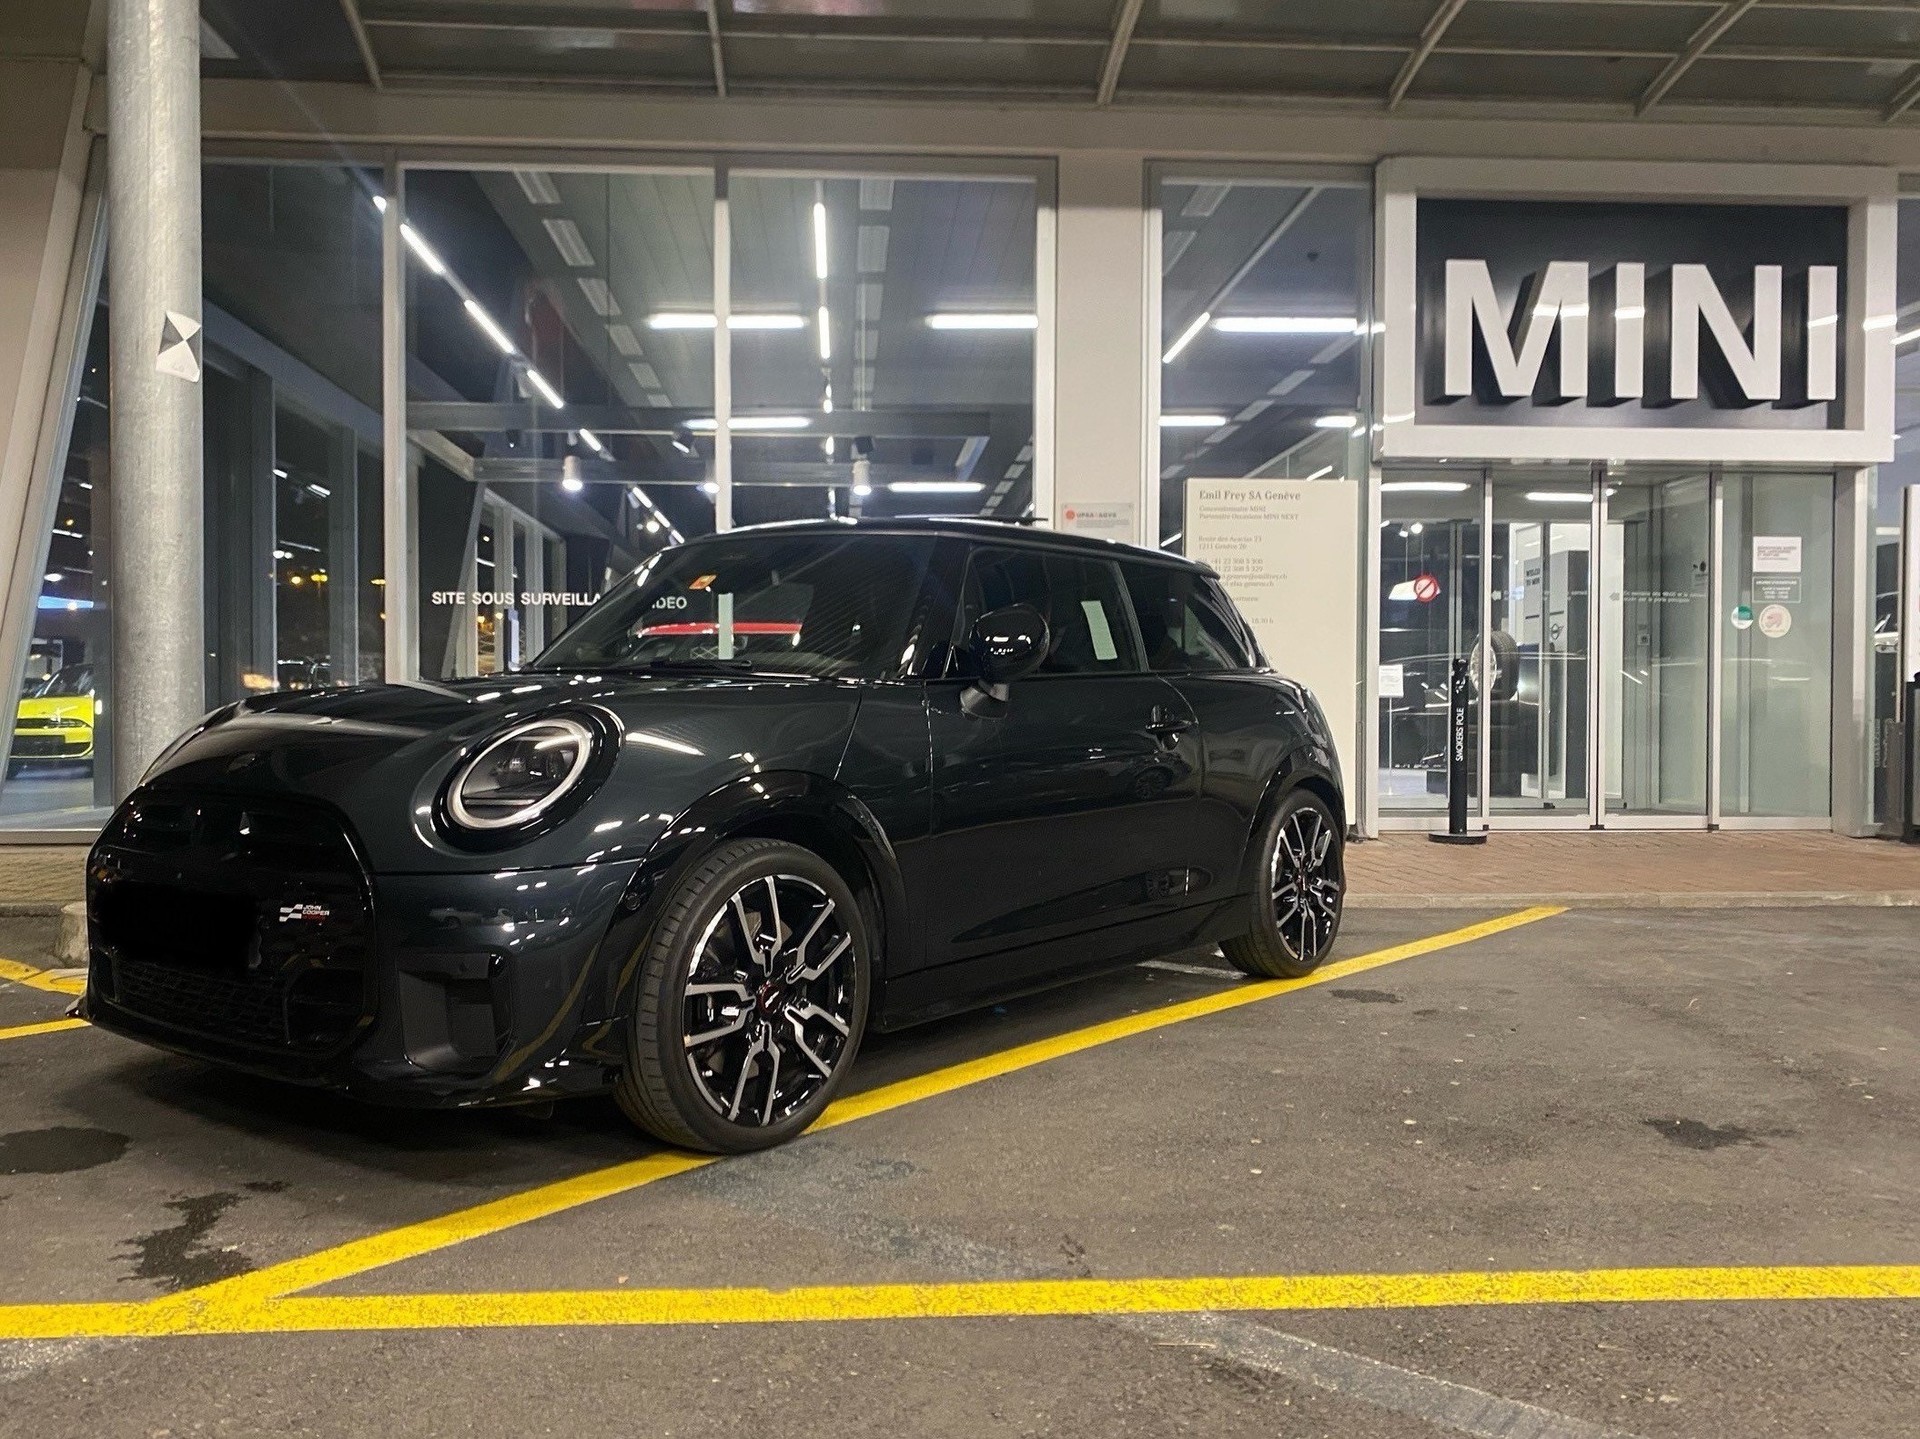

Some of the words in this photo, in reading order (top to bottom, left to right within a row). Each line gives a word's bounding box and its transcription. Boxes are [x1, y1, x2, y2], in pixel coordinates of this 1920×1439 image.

[1445, 259, 1838, 399] MINI
[1199, 490, 1221, 500] Emil
[1224, 490, 1246, 503] Frey
[1248, 490, 1262, 500] SA
[1264, 490, 1300, 500] Genève
[432, 591, 466, 605] SITE
[472, 591, 515, 605] SOUS
[1456, 707, 1464, 726] POLE
[1455, 727, 1463, 762] SMOKERS
